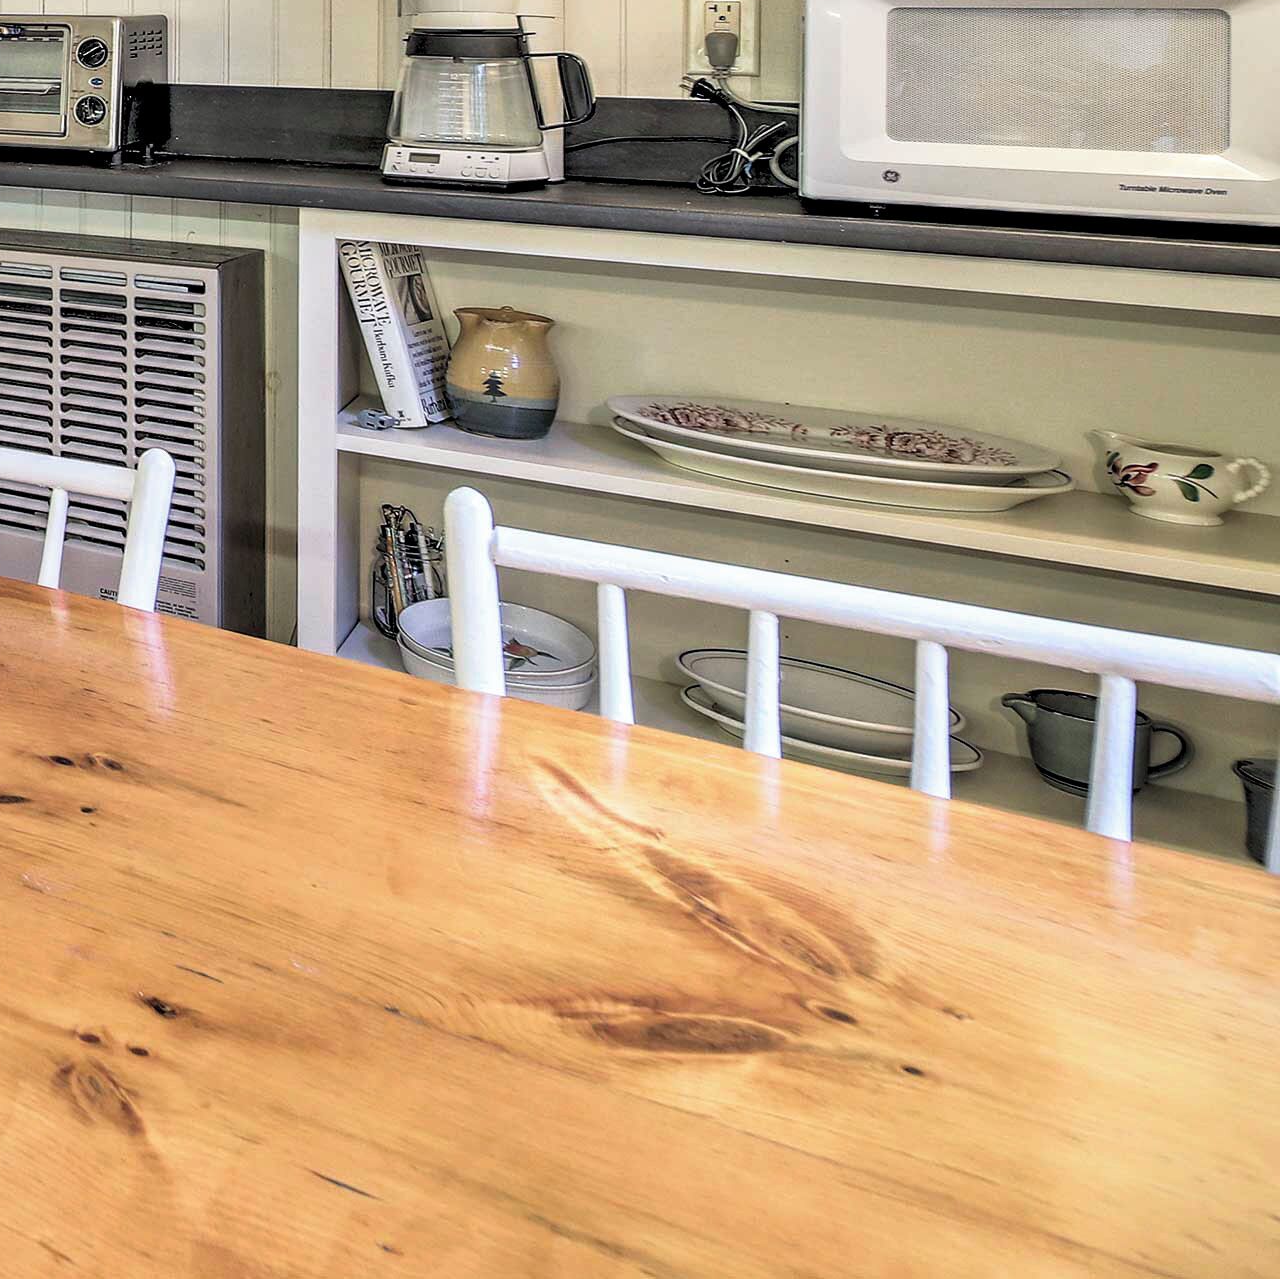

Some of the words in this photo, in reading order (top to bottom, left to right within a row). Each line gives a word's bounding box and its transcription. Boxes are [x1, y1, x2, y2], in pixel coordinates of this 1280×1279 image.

[1158, 186, 1203, 194] Microwave
[1204, 188, 1228, 196] Oven
[340, 242, 378, 327] GOURMET
[357, 241, 392, 327] MICROWAVE
[100, 587, 118, 597] CAUTI
